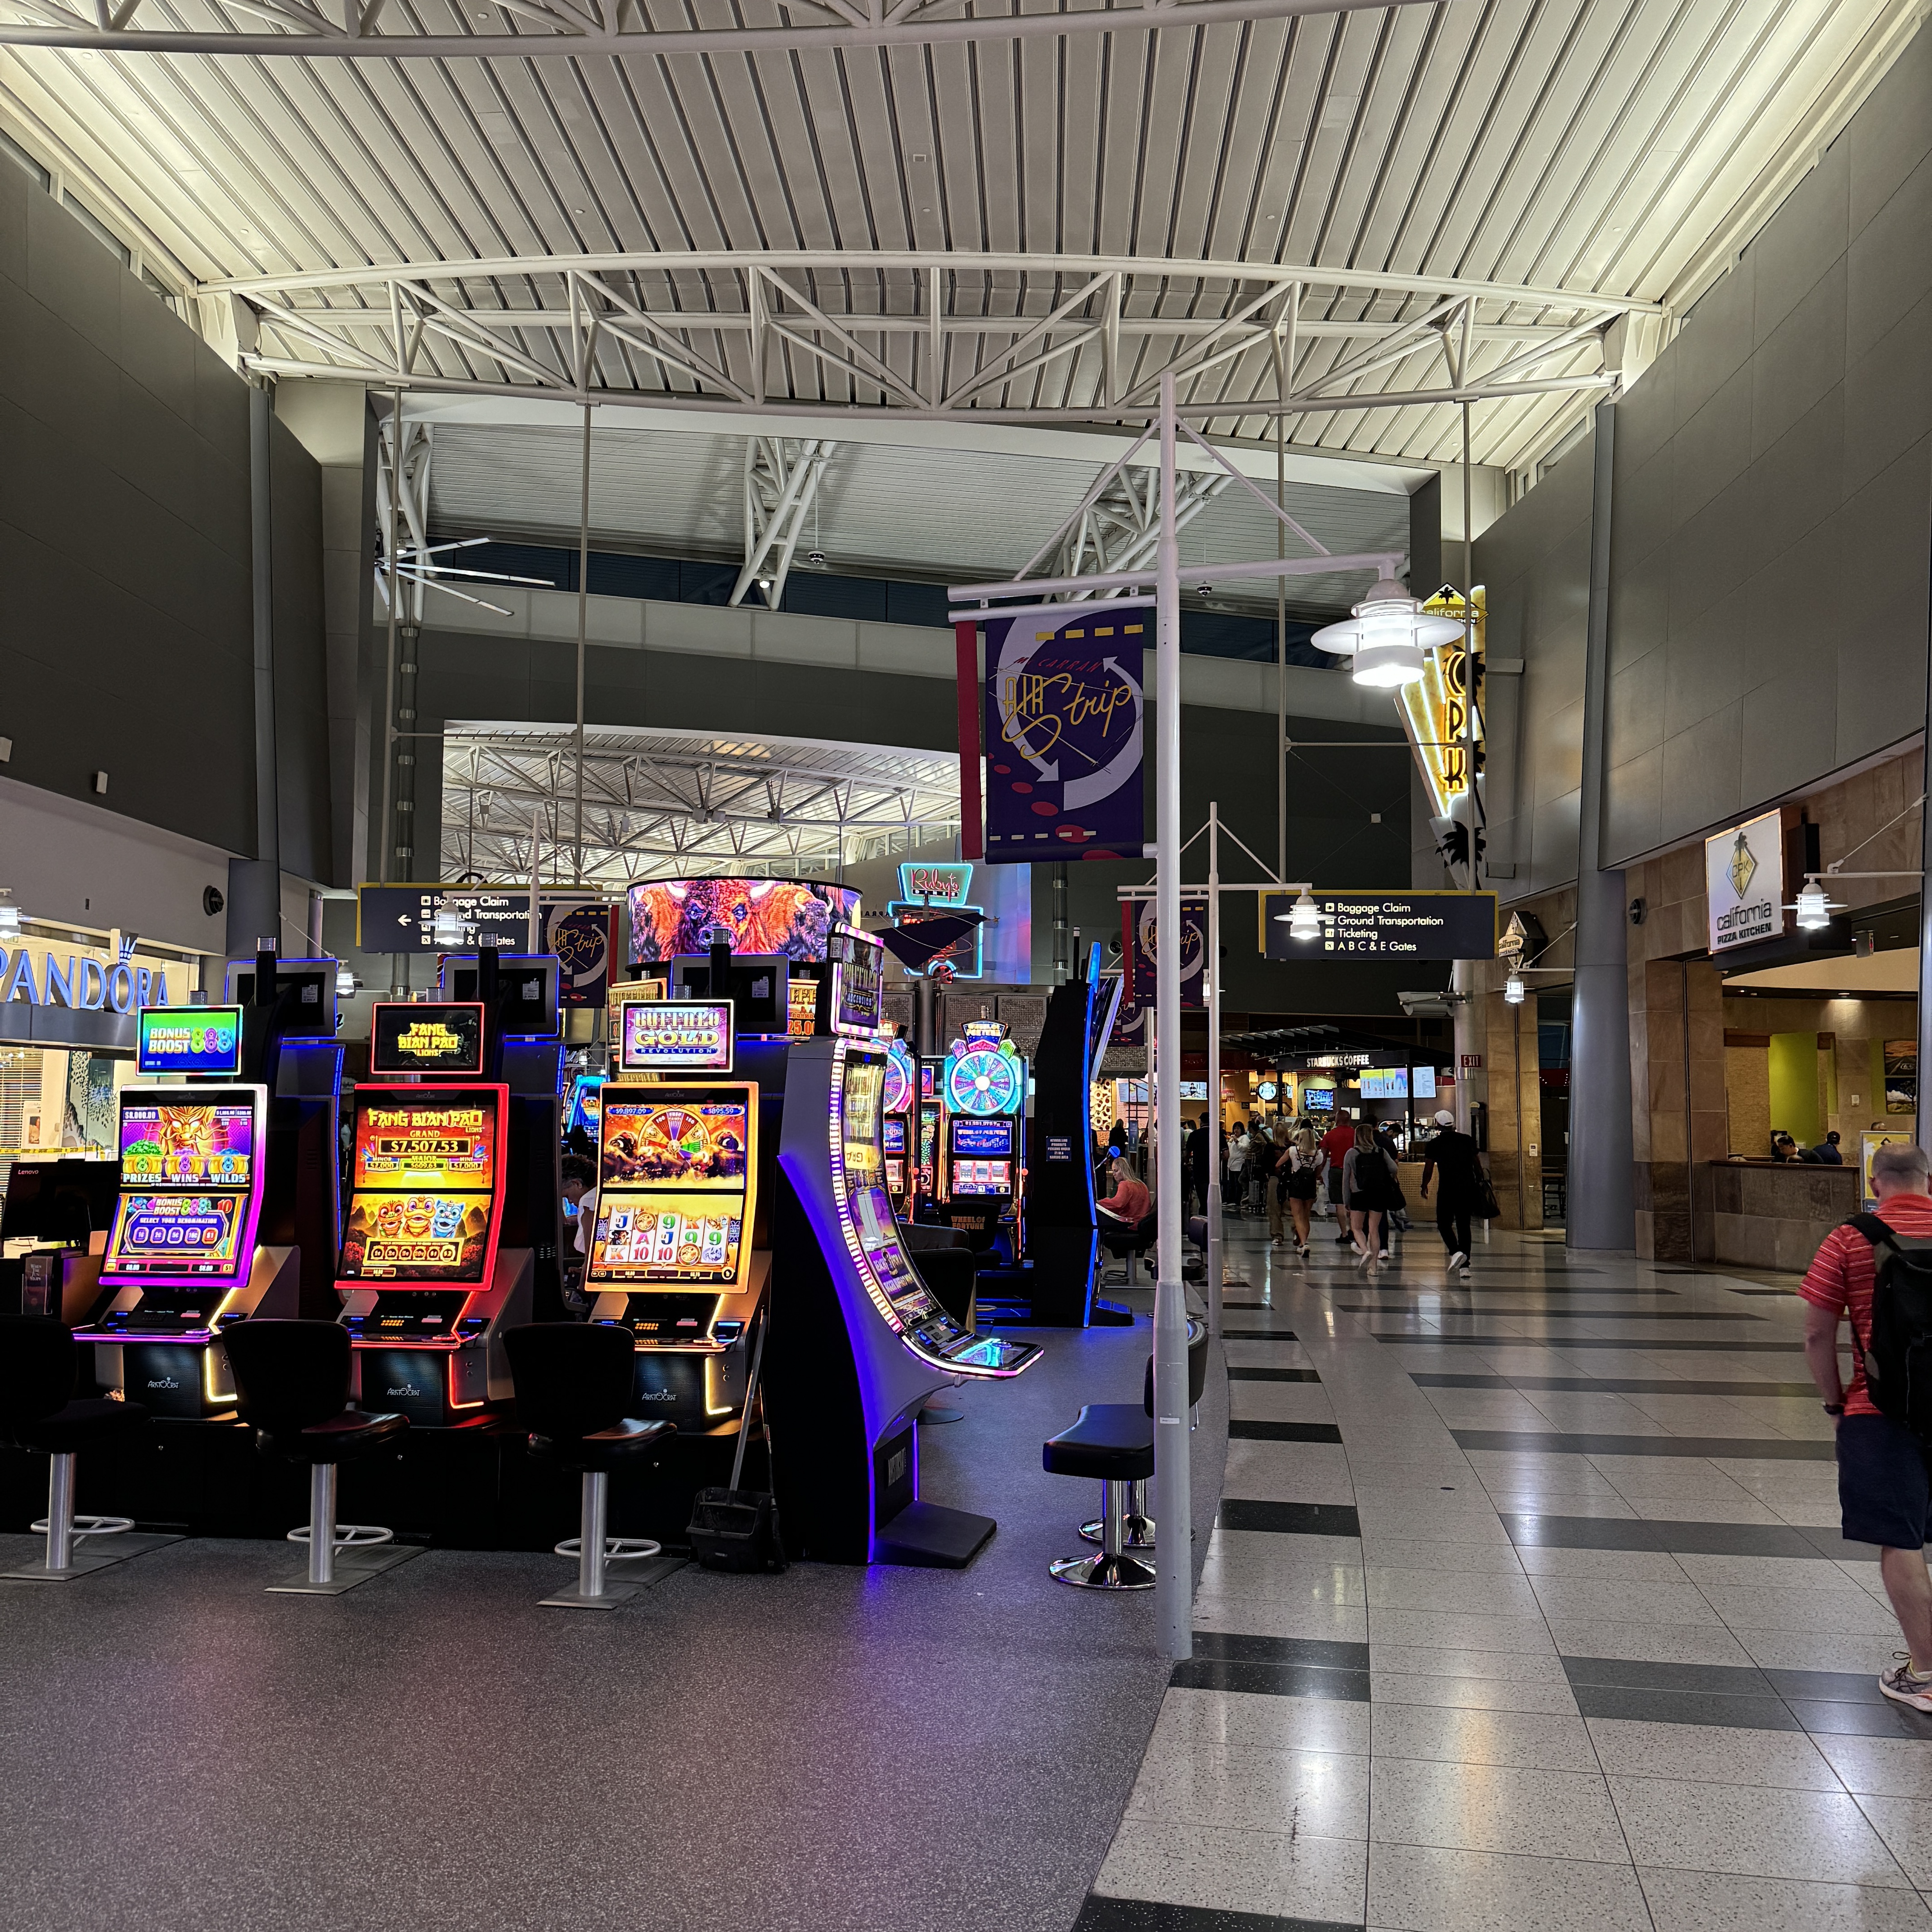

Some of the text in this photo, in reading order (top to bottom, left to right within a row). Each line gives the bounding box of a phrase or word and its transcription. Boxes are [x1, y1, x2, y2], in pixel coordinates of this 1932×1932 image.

[1002, 673, 1132, 759] Strip
[1732, 860, 1750, 878] CPK
[911, 869, 960, 902] Ruby's
[480, 896, 509, 906] Claim
[1338, 902, 1411, 914] Baggage Claim
[1717, 899, 1771, 930] california
[1338, 915, 1444, 927] Ground Transportation
[1338, 928, 1378, 940] Ticketing
[1717, 922, 1771, 944] PIZZA KITCHEN
[467, 937, 475, 945] &
[1338, 941, 1417, 951] A B C & E Gates
[150, 1027, 190, 1039] BONUS
[410, 1023, 446, 1036] FANG
[398, 1036, 458, 1049] BIAN PAO
[635, 1030, 719, 1046] GOLD
[148, 1039, 190, 1053] BOOST
[1307, 1054, 1370, 1067] STARBUCKS COFFEE
[1463, 1056, 1479, 1067] EXIT
[368, 1109, 483, 1128] FANG BIAN PAO
[391, 1140, 458, 1153] $7,507.53
[122, 1173, 246, 1183] PRIZES WINS WILDS
[156, 1198, 183, 1207] BONUS
[217, 1199, 233, 1214] 10
[153, 1206, 181, 1216] BOOST
[615, 1215, 628, 1228] J
[662, 1215, 676, 1229] 9
[636, 1231, 722, 1245] A J 9 9
[633, 1247, 649, 1260] 10
[657, 1247, 673, 1260] 10
